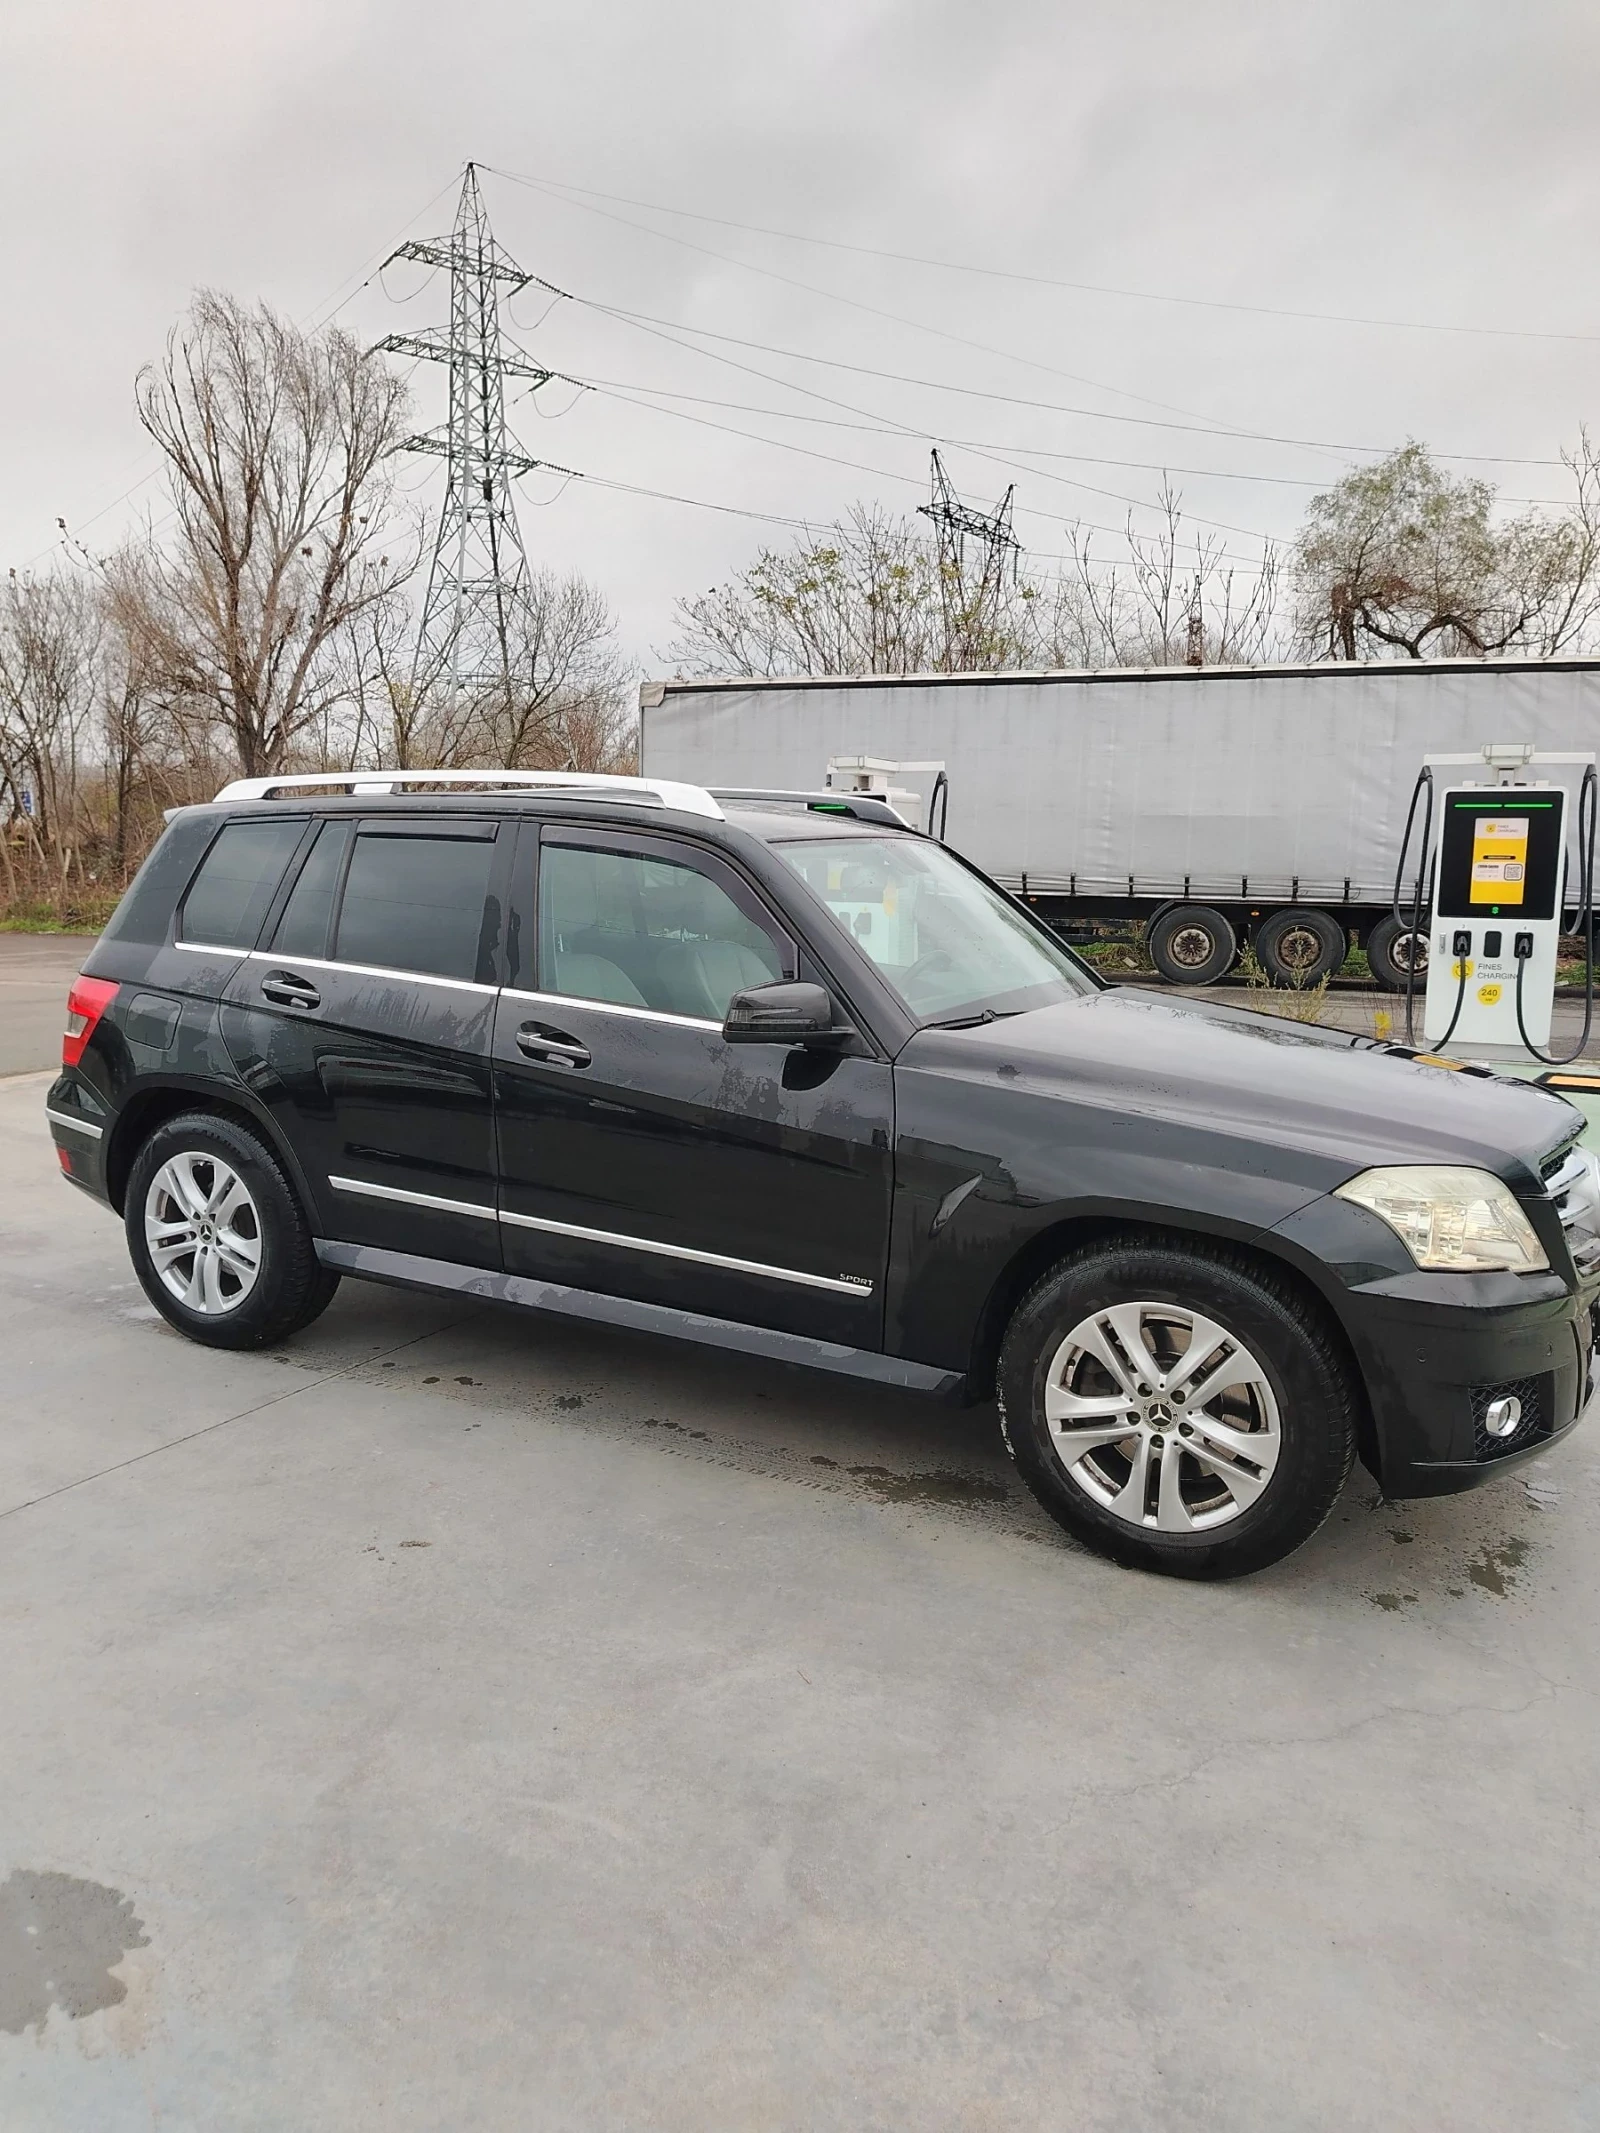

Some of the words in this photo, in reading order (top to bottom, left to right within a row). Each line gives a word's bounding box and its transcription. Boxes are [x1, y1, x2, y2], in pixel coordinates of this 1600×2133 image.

[1477, 963, 1503, 971] FINES
[1477, 972, 1518, 980] CHARGIN
[1481, 988, 1498, 997] 240
[839, 1273, 874, 1286] SPORT
